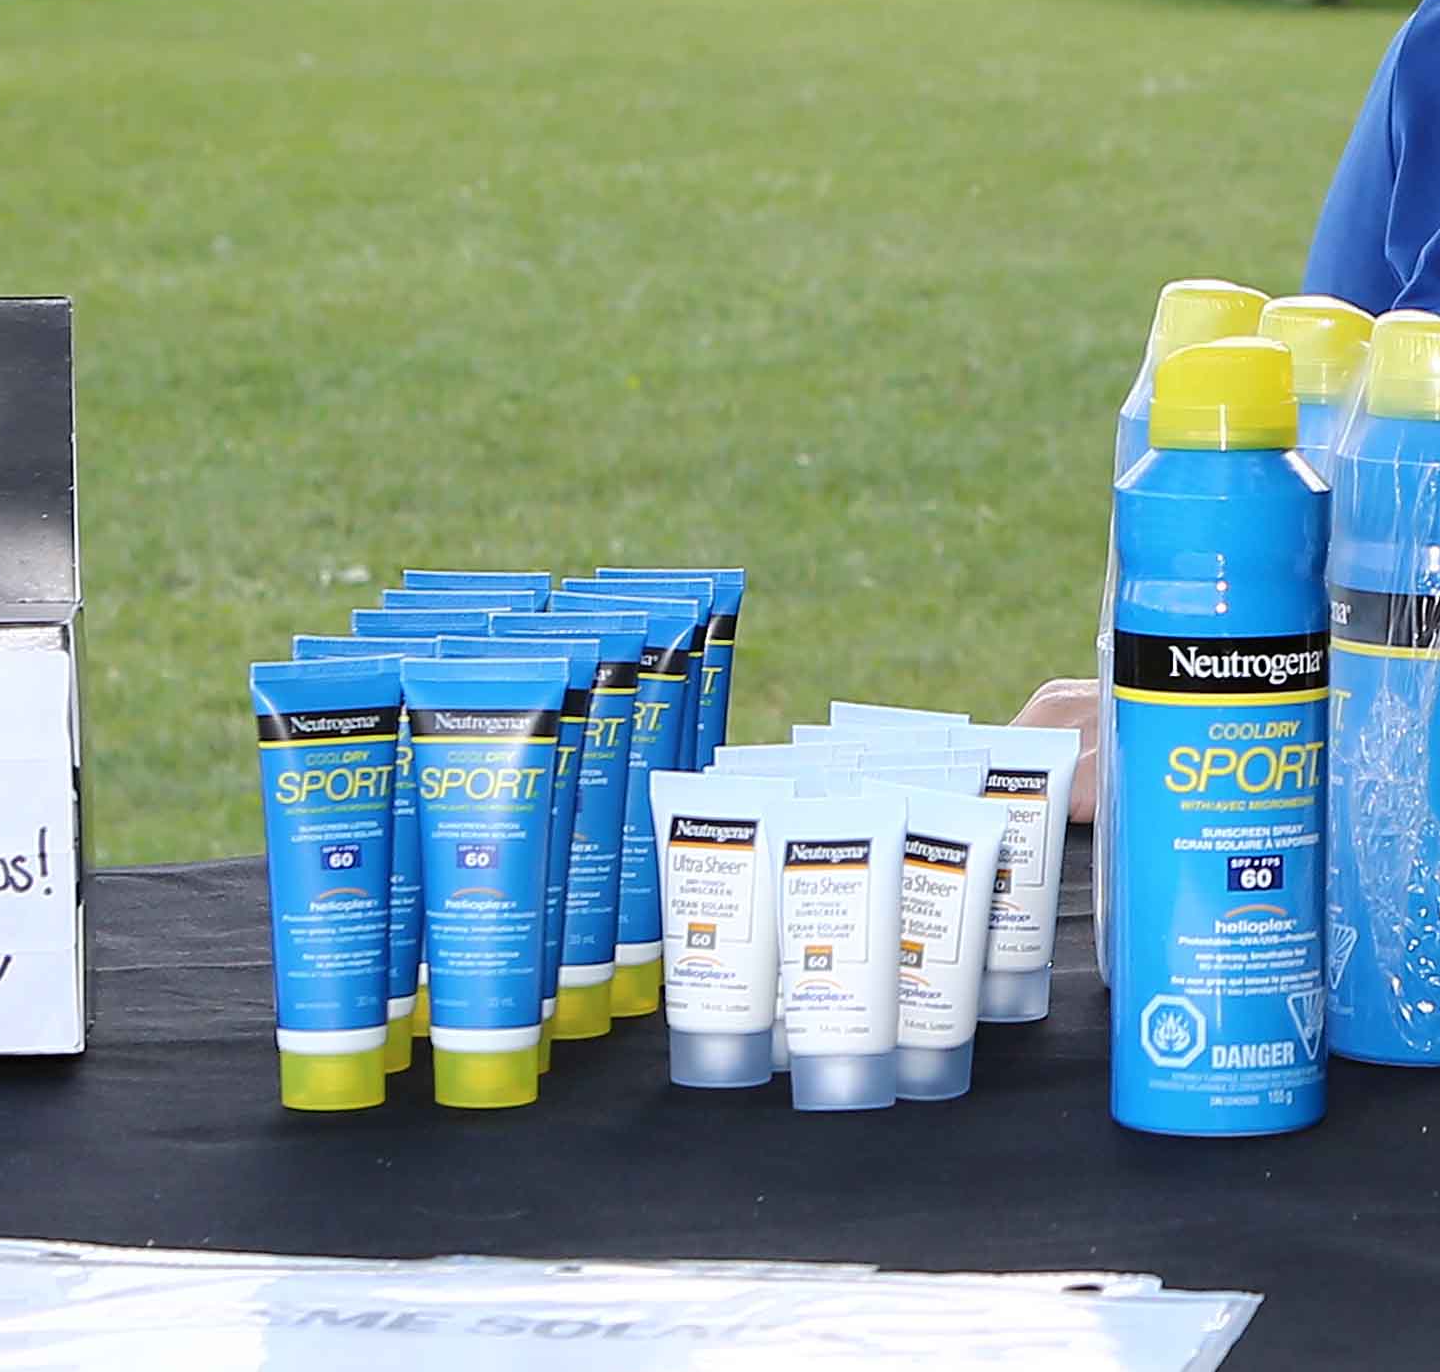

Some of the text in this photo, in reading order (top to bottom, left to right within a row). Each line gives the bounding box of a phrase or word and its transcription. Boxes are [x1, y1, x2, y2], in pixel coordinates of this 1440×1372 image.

[1168, 645, 1322, 685] Neutrogena
[290, 715, 376, 734] Neutrogena
[434, 712, 528, 734] Neutrogena
[1209, 720, 1301, 741] COOLDRY
[1164, 741, 1324, 794] SPORT
[275, 765, 393, 804] SPORT
[420, 766, 545, 800] SPORT
[675, 819, 753, 843] Neutrogena
[329, 852, 354, 869] 60
[464, 852, 490, 867] 60
[788, 843, 864, 864] Neutrogena
[905, 840, 962, 863] utrogena
[704, 854, 743, 876] Sheer
[912, 874, 951, 898] Sheer
[1240, 867, 1273, 889] 60
[691, 932, 711, 946] 60
[807, 954, 829, 968] 60
[1212, 1041, 1296, 1069] DANGER
